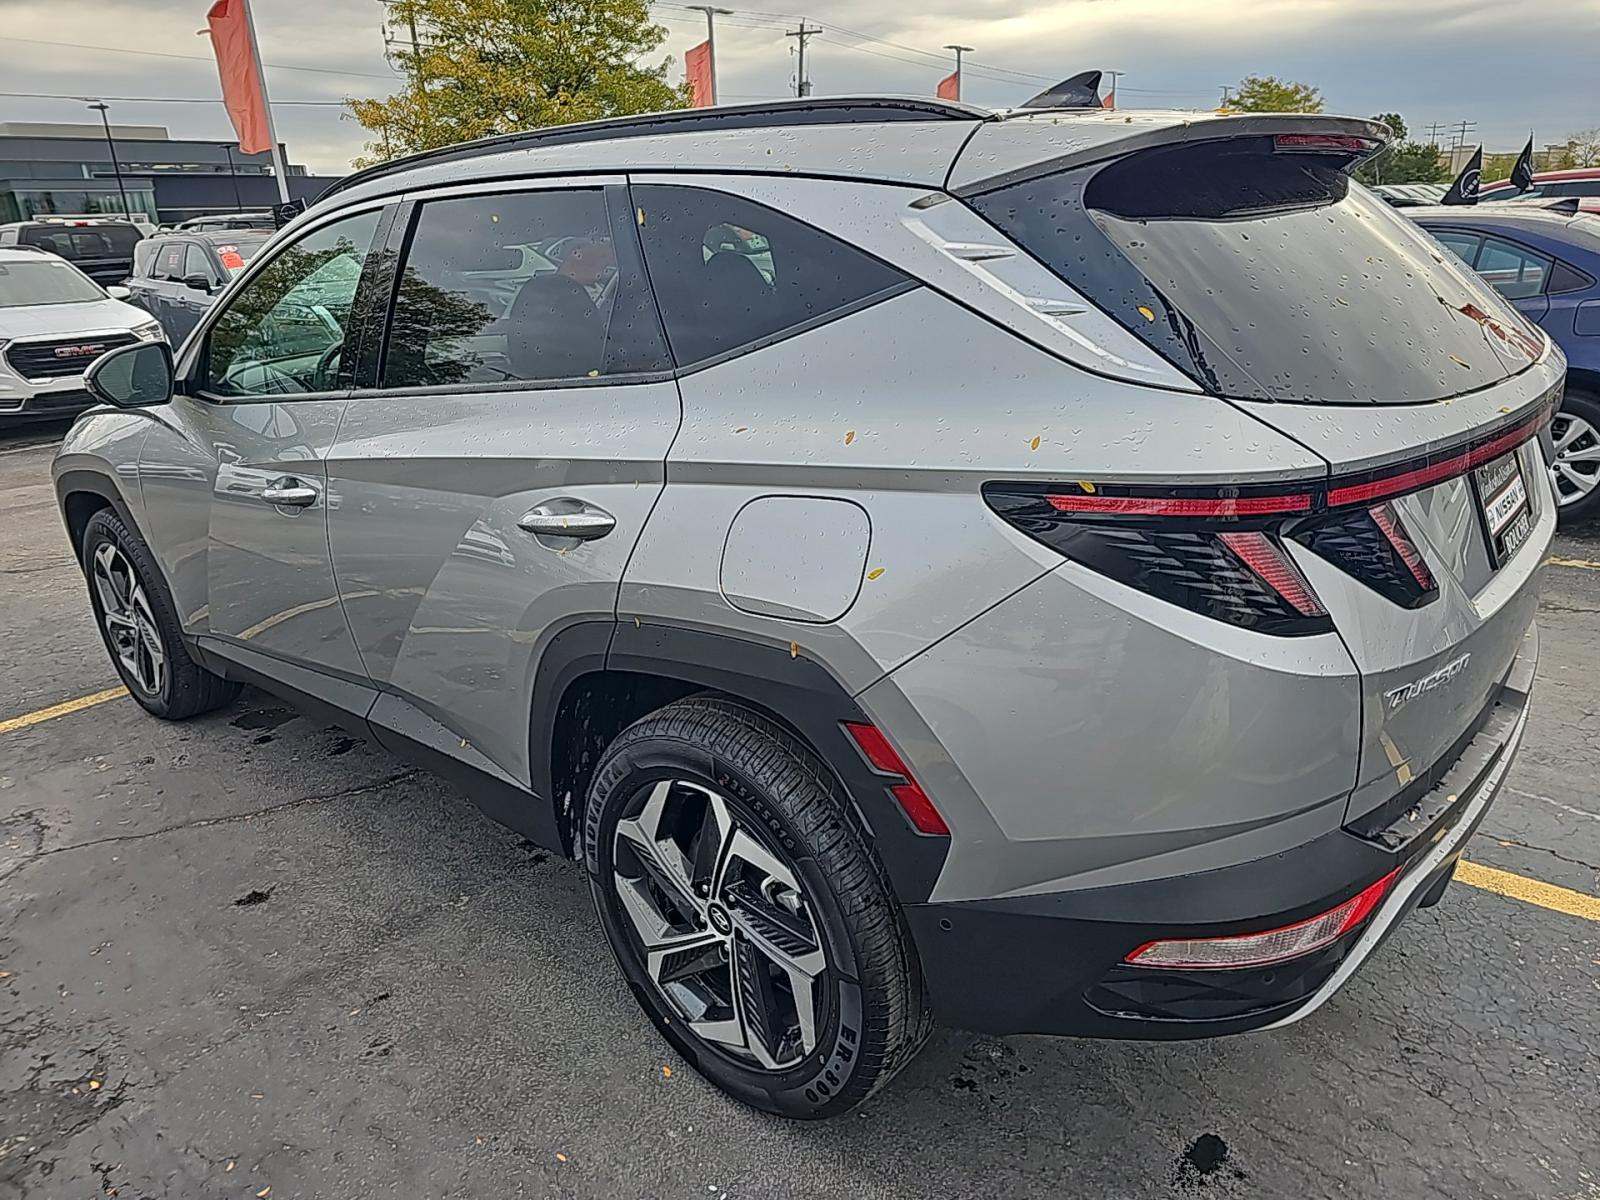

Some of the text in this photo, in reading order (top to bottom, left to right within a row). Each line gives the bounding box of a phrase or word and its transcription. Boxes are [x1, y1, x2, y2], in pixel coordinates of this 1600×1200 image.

[54, 344, 105, 357] GMC
[1494, 486, 1519, 521] NISSAN
[586, 763, 624, 862] ADVANTA
